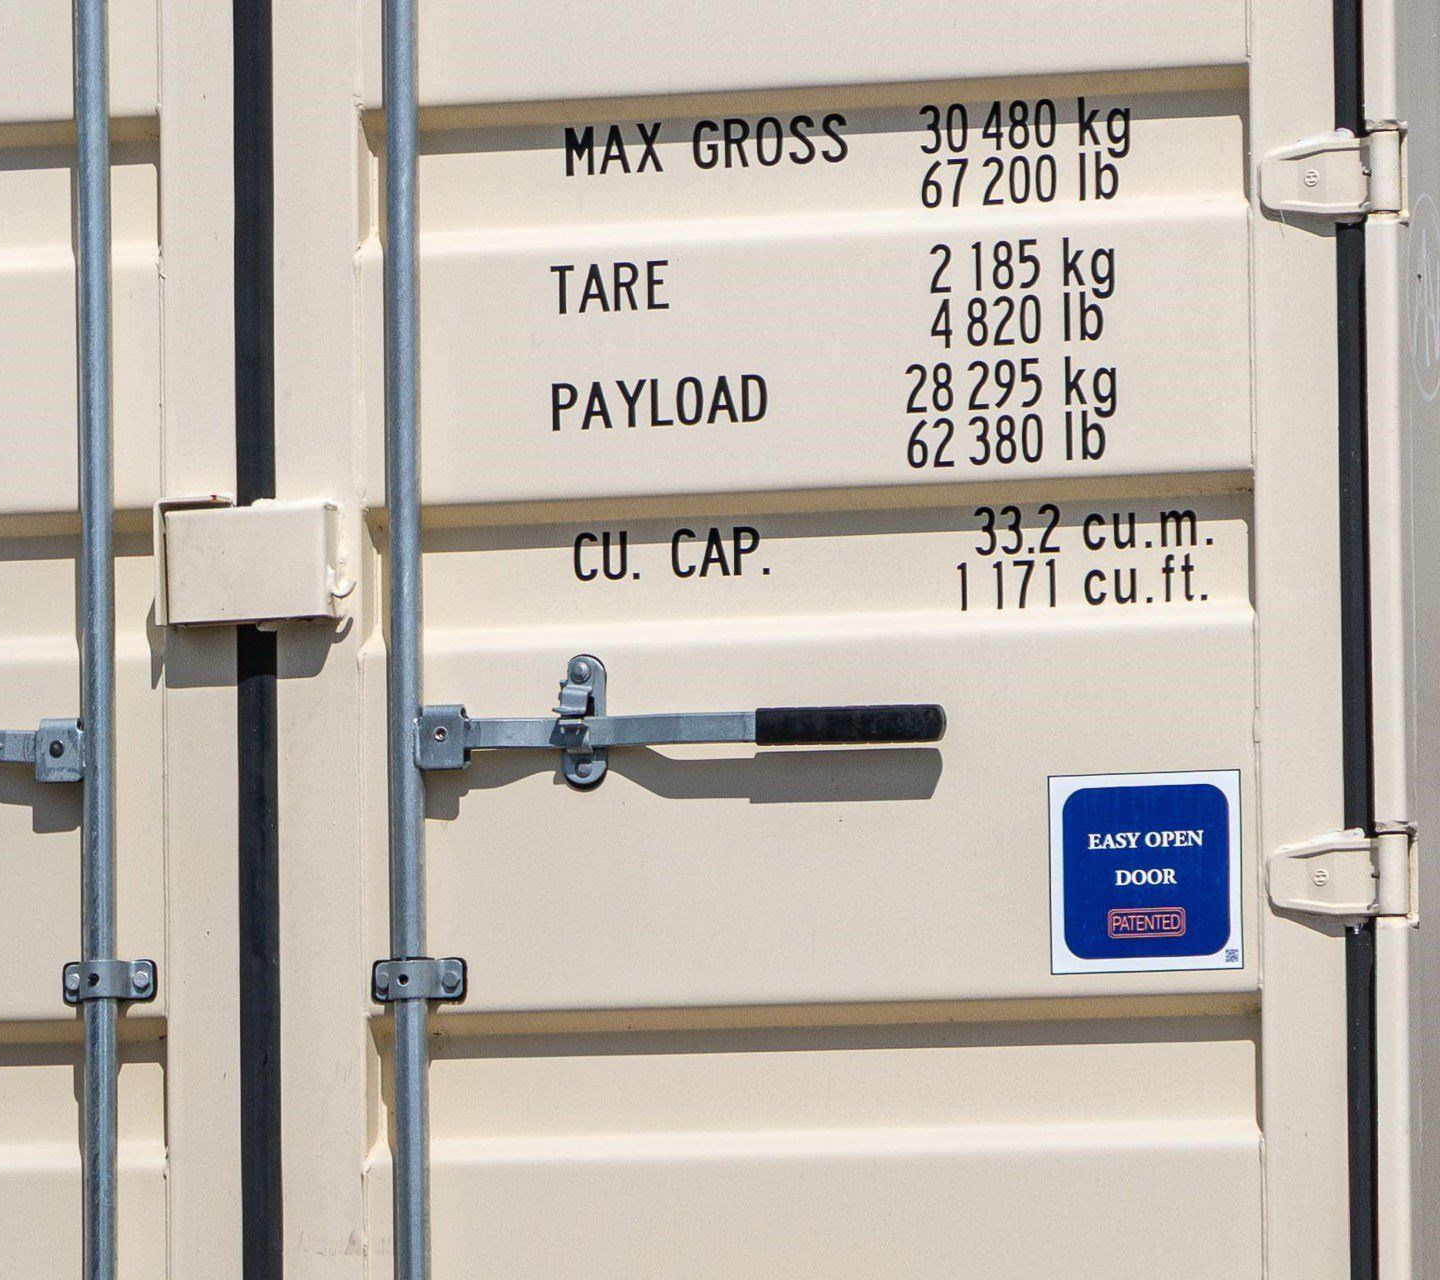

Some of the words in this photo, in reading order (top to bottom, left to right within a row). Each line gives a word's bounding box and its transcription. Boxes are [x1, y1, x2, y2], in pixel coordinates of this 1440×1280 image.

[563, 121, 664, 177] MAX
[692, 112, 848, 170] GROSS
[1077, 96, 1132, 158] kg
[1079, 153, 1120, 201] lb
[550, 259, 669, 315] TARE
[1062, 237, 1116, 298] kg
[1063, 292, 1105, 342] lb
[551, 374, 767, 432] PAYLOAD
[1064, 356, 1118, 418] kg
[1065, 411, 1107, 461] lb
[573, 530, 640, 582] CU.
[671, 526, 770, 578] CAP.
[973, 503, 1061, 556] 33.2
[1083, 509, 1213, 551] cu.m.
[1084, 553, 1208, 606] cu.ft.
[1087, 832, 1141, 850] EASY
[1144, 830, 1204, 848] OPEN
[1114, 868, 1178, 886] DOOR
[1111, 913, 1181, 932] PATENTED
